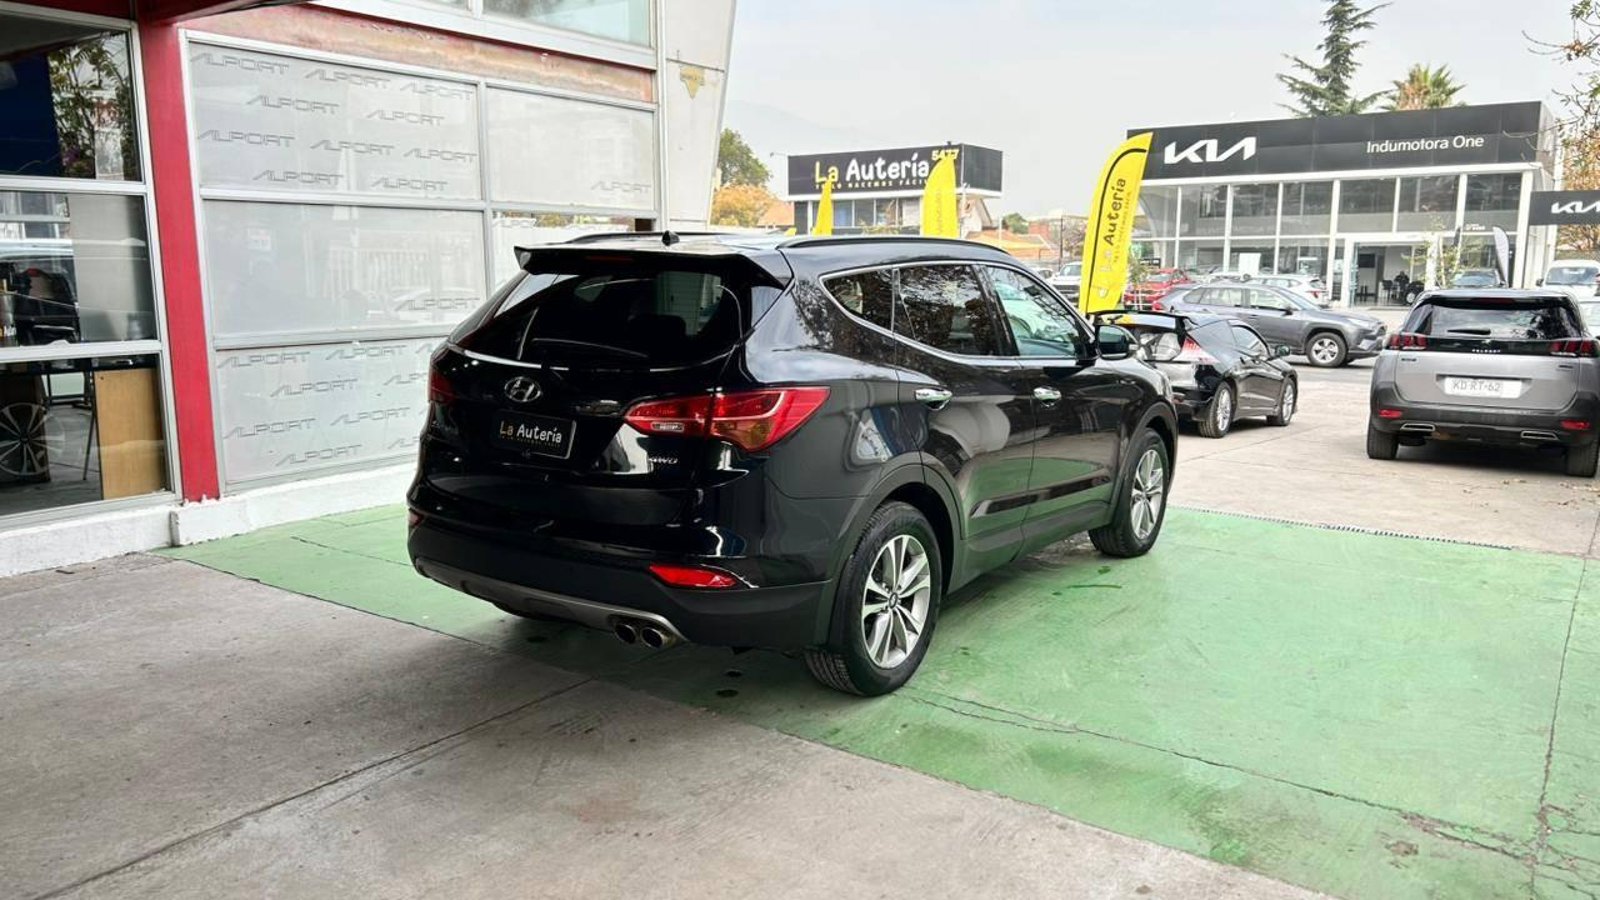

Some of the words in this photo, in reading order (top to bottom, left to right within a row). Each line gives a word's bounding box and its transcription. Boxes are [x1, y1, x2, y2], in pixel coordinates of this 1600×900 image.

[1164, 136, 1257, 164] KIA
[1366, 138, 1449, 153] Indumotora
[1453, 135, 1485, 148] One
[814, 161, 839, 183] La
[845, 152, 930, 181] Autería
[500, 420, 514, 436] La
[517, 423, 562, 443] Autería
